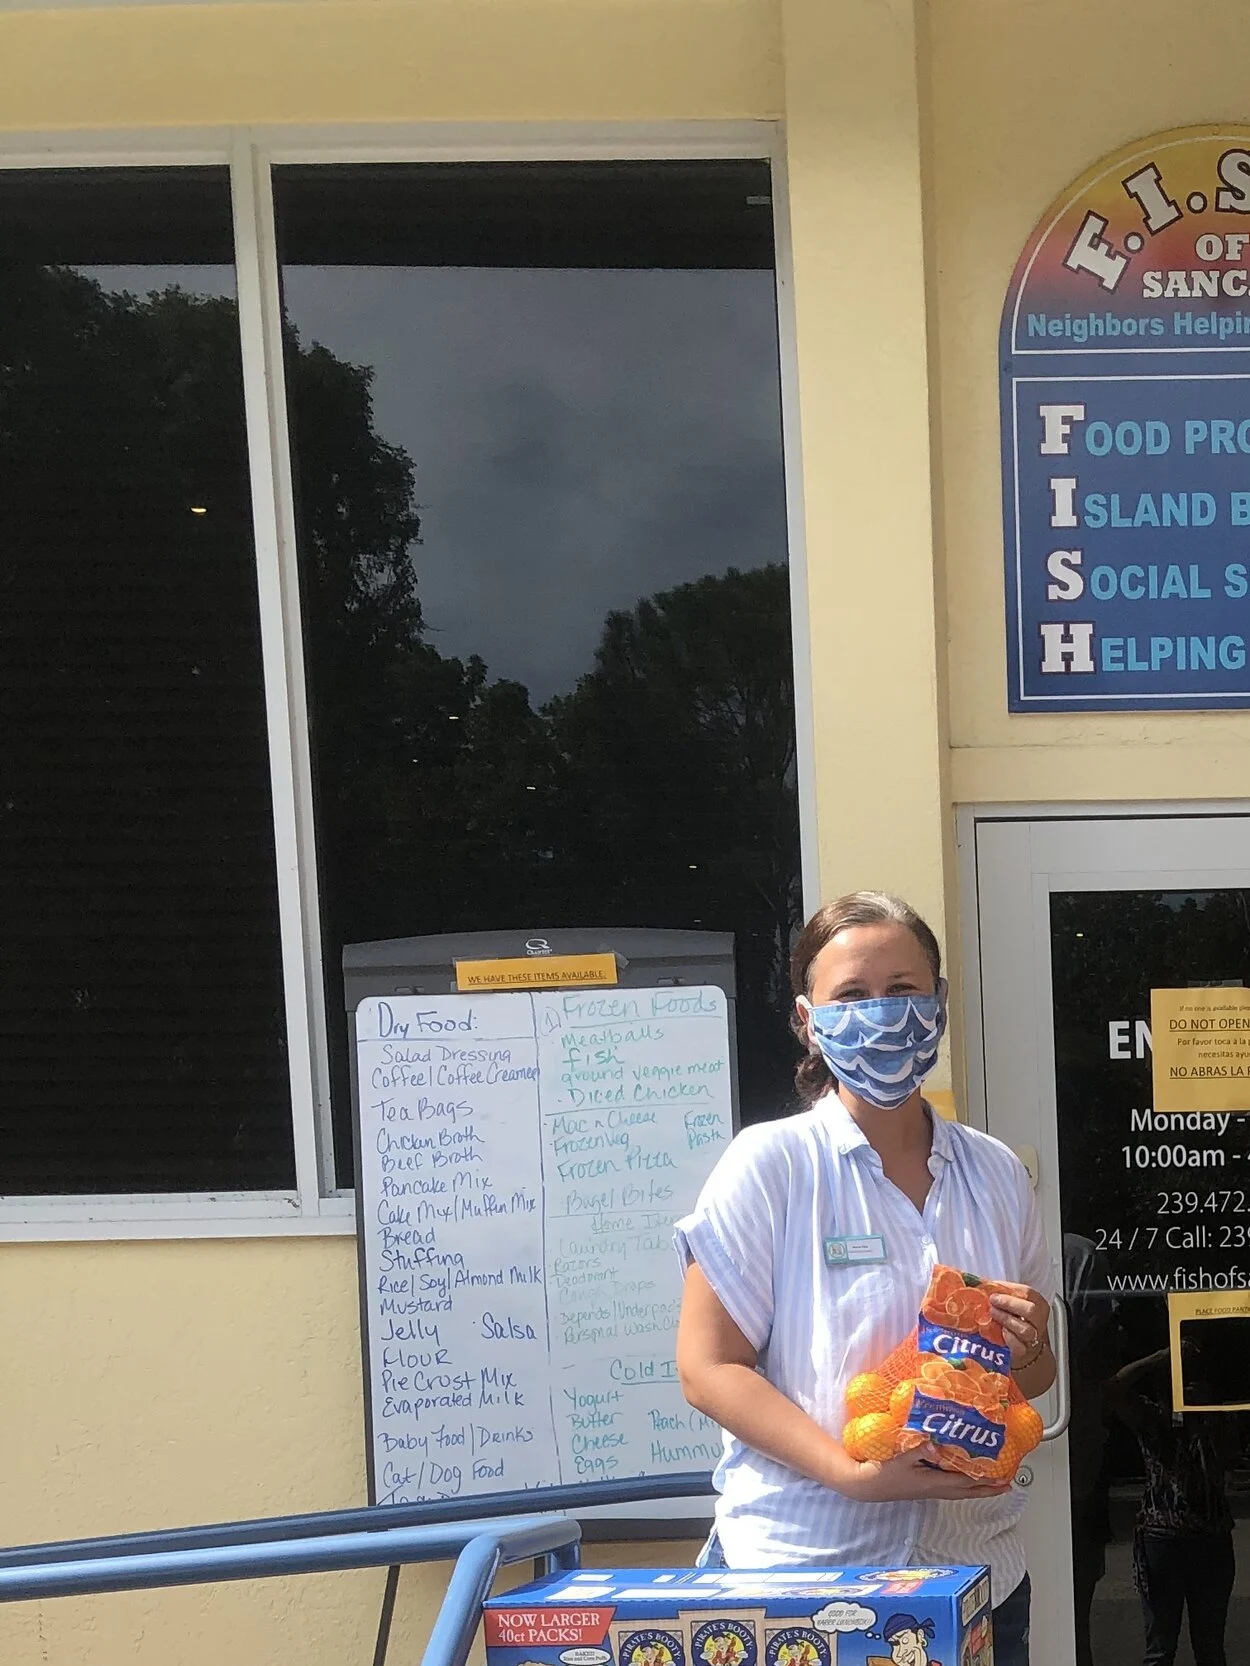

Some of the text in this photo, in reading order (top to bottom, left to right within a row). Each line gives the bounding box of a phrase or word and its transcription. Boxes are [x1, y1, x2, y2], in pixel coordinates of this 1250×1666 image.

[1195, 233, 1250, 261] OF
[1027, 314, 1165, 342] Neighbors
[1039, 404, 1170, 456] FOOD
[1049, 476, 1216, 529] ISLAND
[1046, 548, 1211, 601] SOCIAL
[1040, 623, 1246, 675] HELPING
[508, 973, 532, 982] THESE
[534, 972, 559, 980] ITEMS
[563, 995, 639, 1019] Frozen
[378, 1001, 409, 1039] Dry
[1169, 1019, 1186, 1029] DO
[1191, 1019, 1215, 1029] NOT
[1219, 1019, 1250, 1029] OPEN
[561, 1025, 665, 1048] Meatballs
[381, 1044, 511, 1065] Salad Dressing
[1170, 1067, 1187, 1076] NO
[1191, 1066, 1227, 1076] ABRAS
[1231, 1066, 1244, 1075] LA
[633, 1082, 716, 1101] Chicken
[371, 1097, 473, 1123] Tea Bags
[1130, 1108, 1230, 1136] Monday
[439, 1126, 485, 1149] Broth
[552, 1117, 588, 1135] Mac
[382, 1147, 483, 1173] Beef Broth
[1122, 1145, 1225, 1169] 10:00am
[557, 1158, 619, 1183] Frozen
[381, 1169, 492, 1198] Pancake Mix
[512, 1187, 536, 1213] Mix
[378, 1227, 436, 1248] Bread
[1166, 1226, 1212, 1249] Call:
[381, 1247, 466, 1272] Stuffing
[510, 1265, 542, 1285] Milk
[380, 1295, 452, 1315] Mustard
[381, 1312, 537, 1346] Jelly Salsa
[933, 1334, 1005, 1365] Citrus
[382, 1367, 517, 1393] Pie Crust Mix
[610, 1359, 654, 1380] Cold
[382, 1390, 524, 1421] Evaporated Milk
[563, 1387, 624, 1410] Yogurt
[922, 1412, 1000, 1447] Citrus
[377, 1433, 428, 1457] Baby
[572, 1433, 724, 1463] Cheese Hummu
[472, 1458, 504, 1480] Food
[574, 1455, 618, 1475] Eggs
[498, 1613, 599, 1628] NOW LARGER
[499, 1629, 582, 1642] 40ct PACKS!
